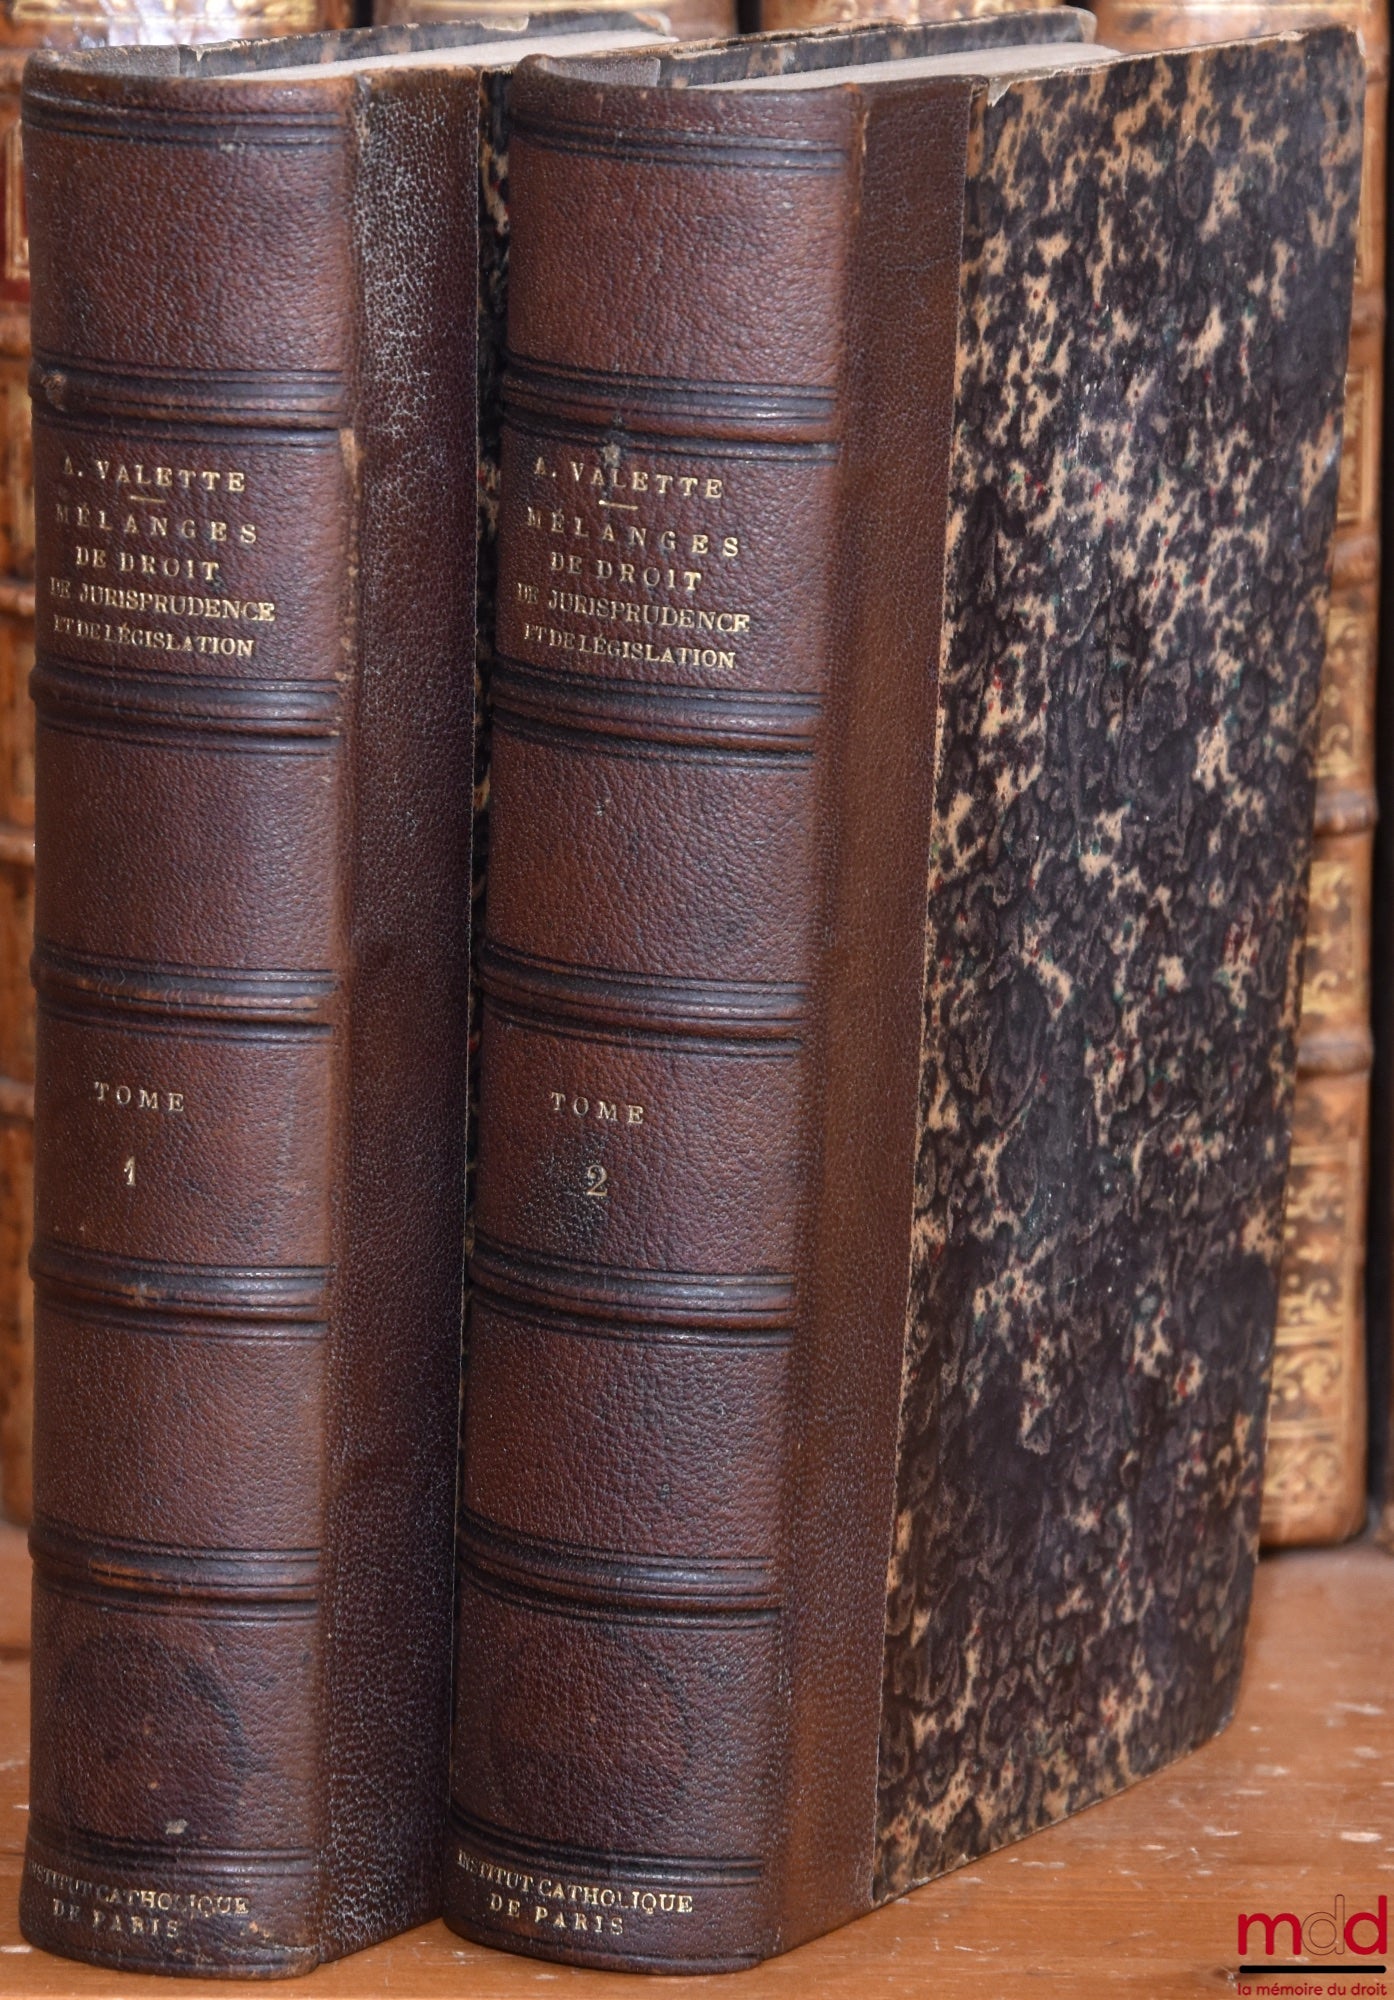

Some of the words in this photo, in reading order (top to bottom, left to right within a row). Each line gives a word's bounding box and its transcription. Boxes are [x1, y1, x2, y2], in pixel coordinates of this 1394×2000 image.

[63, 456, 83, 477] A.
[95, 460, 246, 492] VALETTE
[533, 456, 557, 478] A.
[570, 461, 724, 499] VALETTE
[55, 502, 257, 544] MÉLANGES
[527, 506, 740, 557] MÉLANGES
[75, 546, 107, 569] DE
[119, 551, 220, 581] DROIT
[551, 551, 583, 575] DE
[596, 560, 702, 592] DROIT
[50, 576, 71, 599] DE
[79, 582, 276, 622] JURISPRUDENCE
[517, 582, 539, 605] DE
[548, 589, 751, 633] JURISPRUDENCE
[76, 619, 101, 640] DE
[104, 621, 255, 657] LÉGISLATION
[549, 628, 576, 650] DE
[578, 633, 737, 669] LÉGISLATION
[94, 1081, 185, 1113] TOME
[550, 1091, 645, 1125] TOME
[123, 1155, 136, 1187] 1
[586, 1164, 608, 1197] 2
[457, 1848, 534, 1893] INSTITUT
[538, 1879, 694, 1915] CATHOLIQUE
[52, 1898, 81, 1922] DE
[92, 1908, 180, 1939] PARIS
[488, 1892, 521, 1919] DE
[534, 1905, 624, 1936] PARIS
